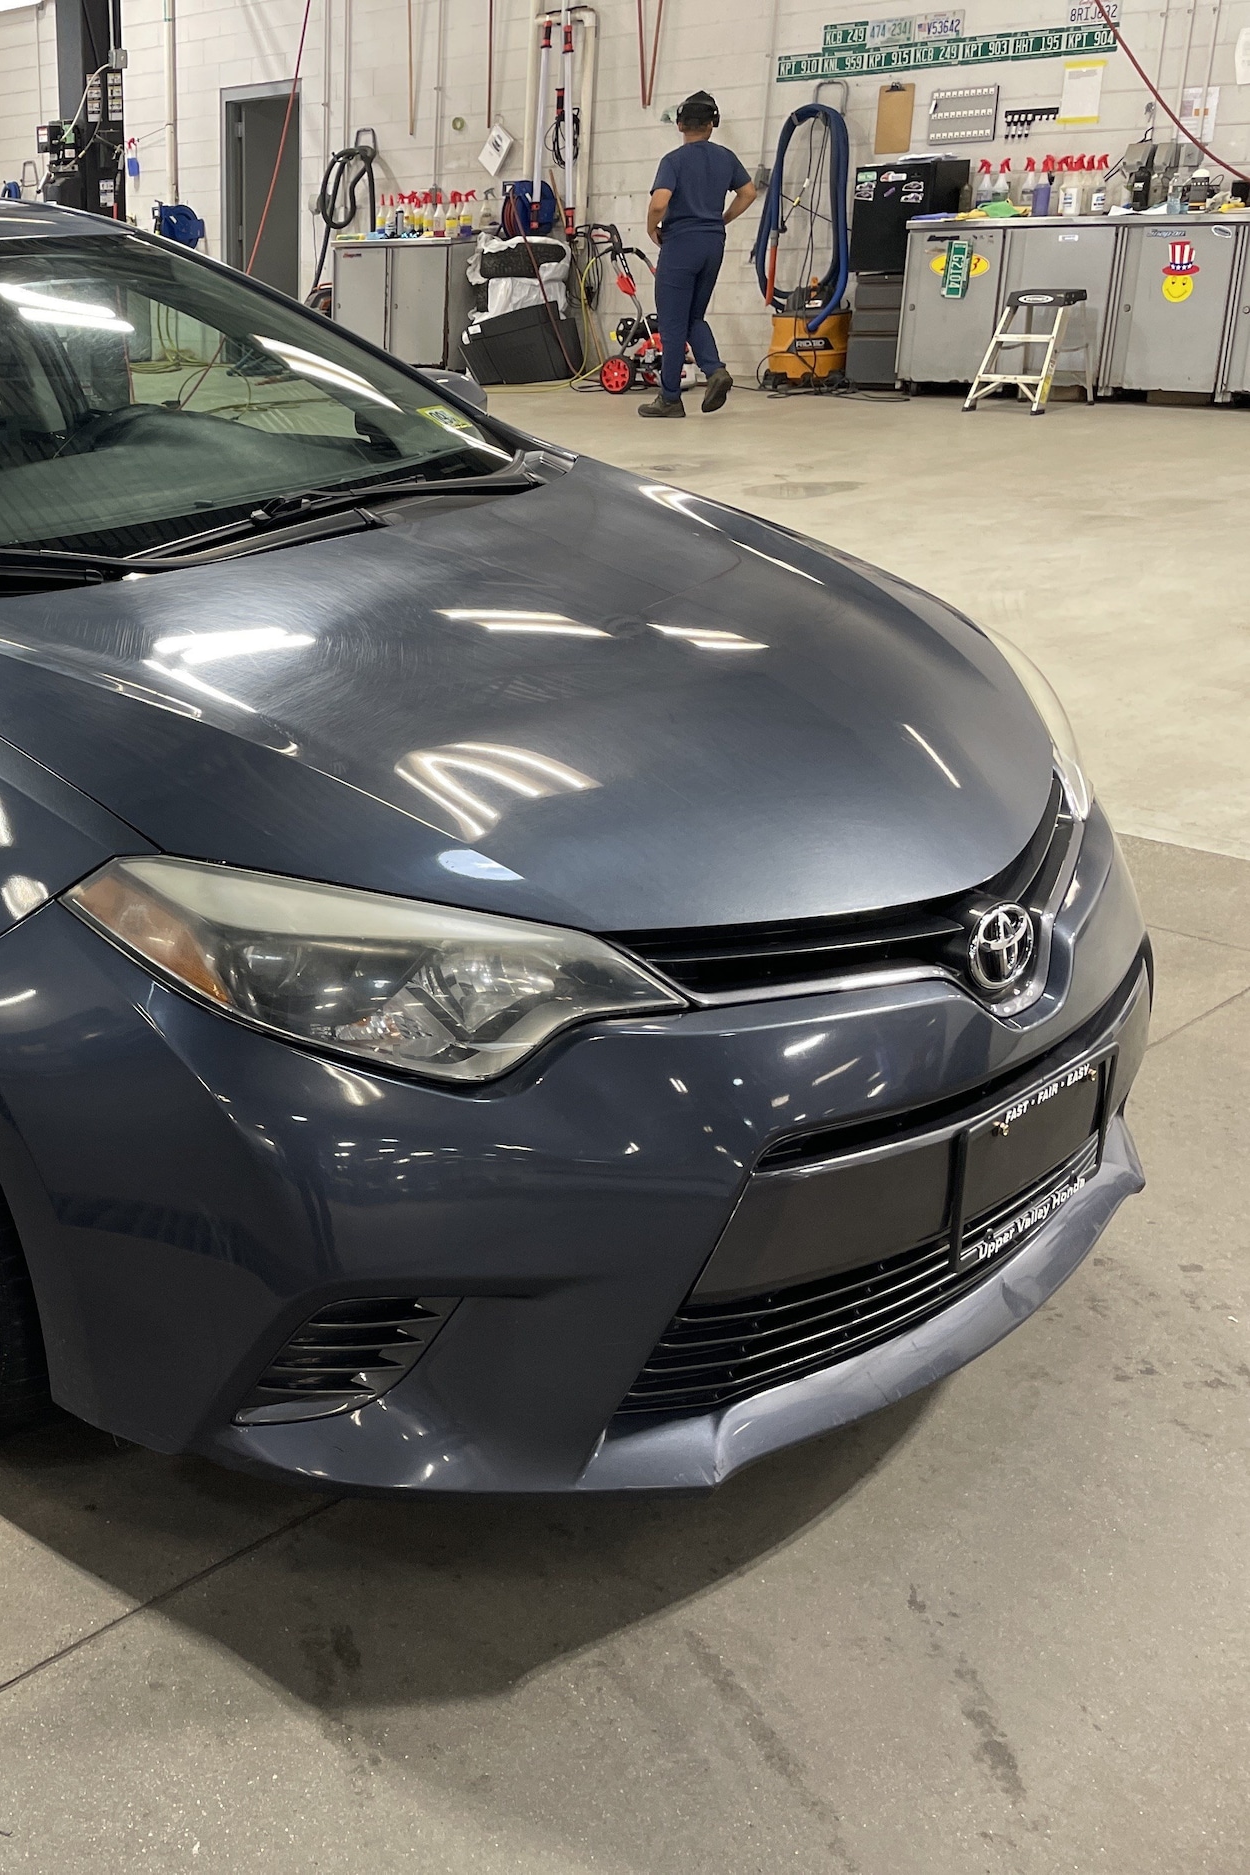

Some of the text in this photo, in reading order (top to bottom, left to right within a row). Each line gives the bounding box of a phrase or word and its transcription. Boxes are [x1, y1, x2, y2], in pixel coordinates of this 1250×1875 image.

[927, 19, 961, 35] V53642
[825, 29, 865, 45] KCB 249
[1015, 36, 1059, 52] HHT 195
[1067, 31, 1114, 48] KPT 904
[915, 46, 957, 63] KCB 249
[964, 41, 1007, 57] KPT 903
[779, 60, 819, 75] KPT 910
[823, 55, 863, 72] KNL 959
[868, 51, 909, 68] KPT 915
[1005, 1063, 1090, 1124] FAST FAIR EASY
[978, 1178, 1086, 1259] Upper Valley Honda
